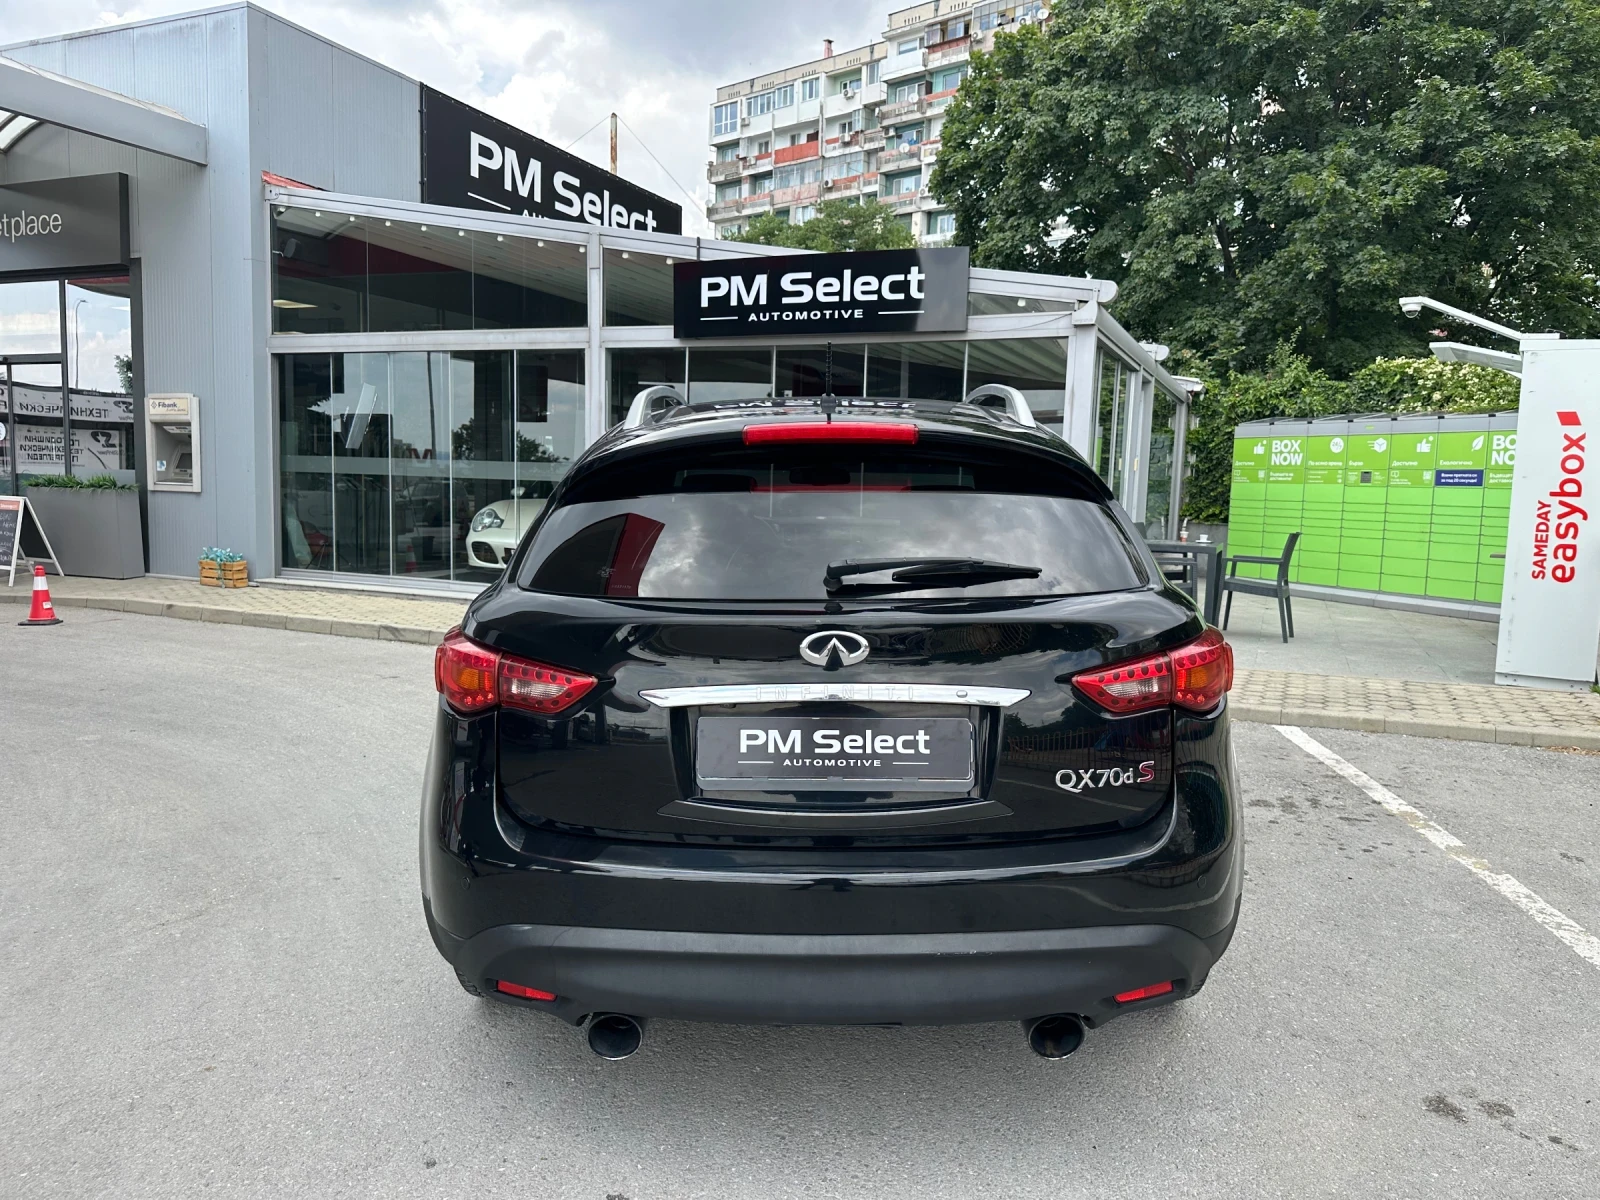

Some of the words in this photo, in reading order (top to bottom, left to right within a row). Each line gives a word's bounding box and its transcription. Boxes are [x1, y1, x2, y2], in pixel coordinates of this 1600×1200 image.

[470, 131, 542, 203] PM
[553, 170, 657, 233] Select
[0, 210, 62, 243] tplace
[701, 274, 768, 308] PM
[780, 266, 925, 304] Select
[748, 309, 864, 322] AUTOMOTIVE
[1272, 440, 1301, 452] BOX
[1492, 434, 1517, 450] BO
[1271, 453, 1303, 466] NOW
[1491, 450, 1516, 466] NO
[1549, 432, 1588, 583] easybox
[1531, 500, 1552, 580] SAMEDAY
[756, 685, 915, 701] INFINITI
[740, 730, 801, 754] PM
[813, 729, 931, 755] Select
[783, 759, 882, 767] AUTOMOTIVE
